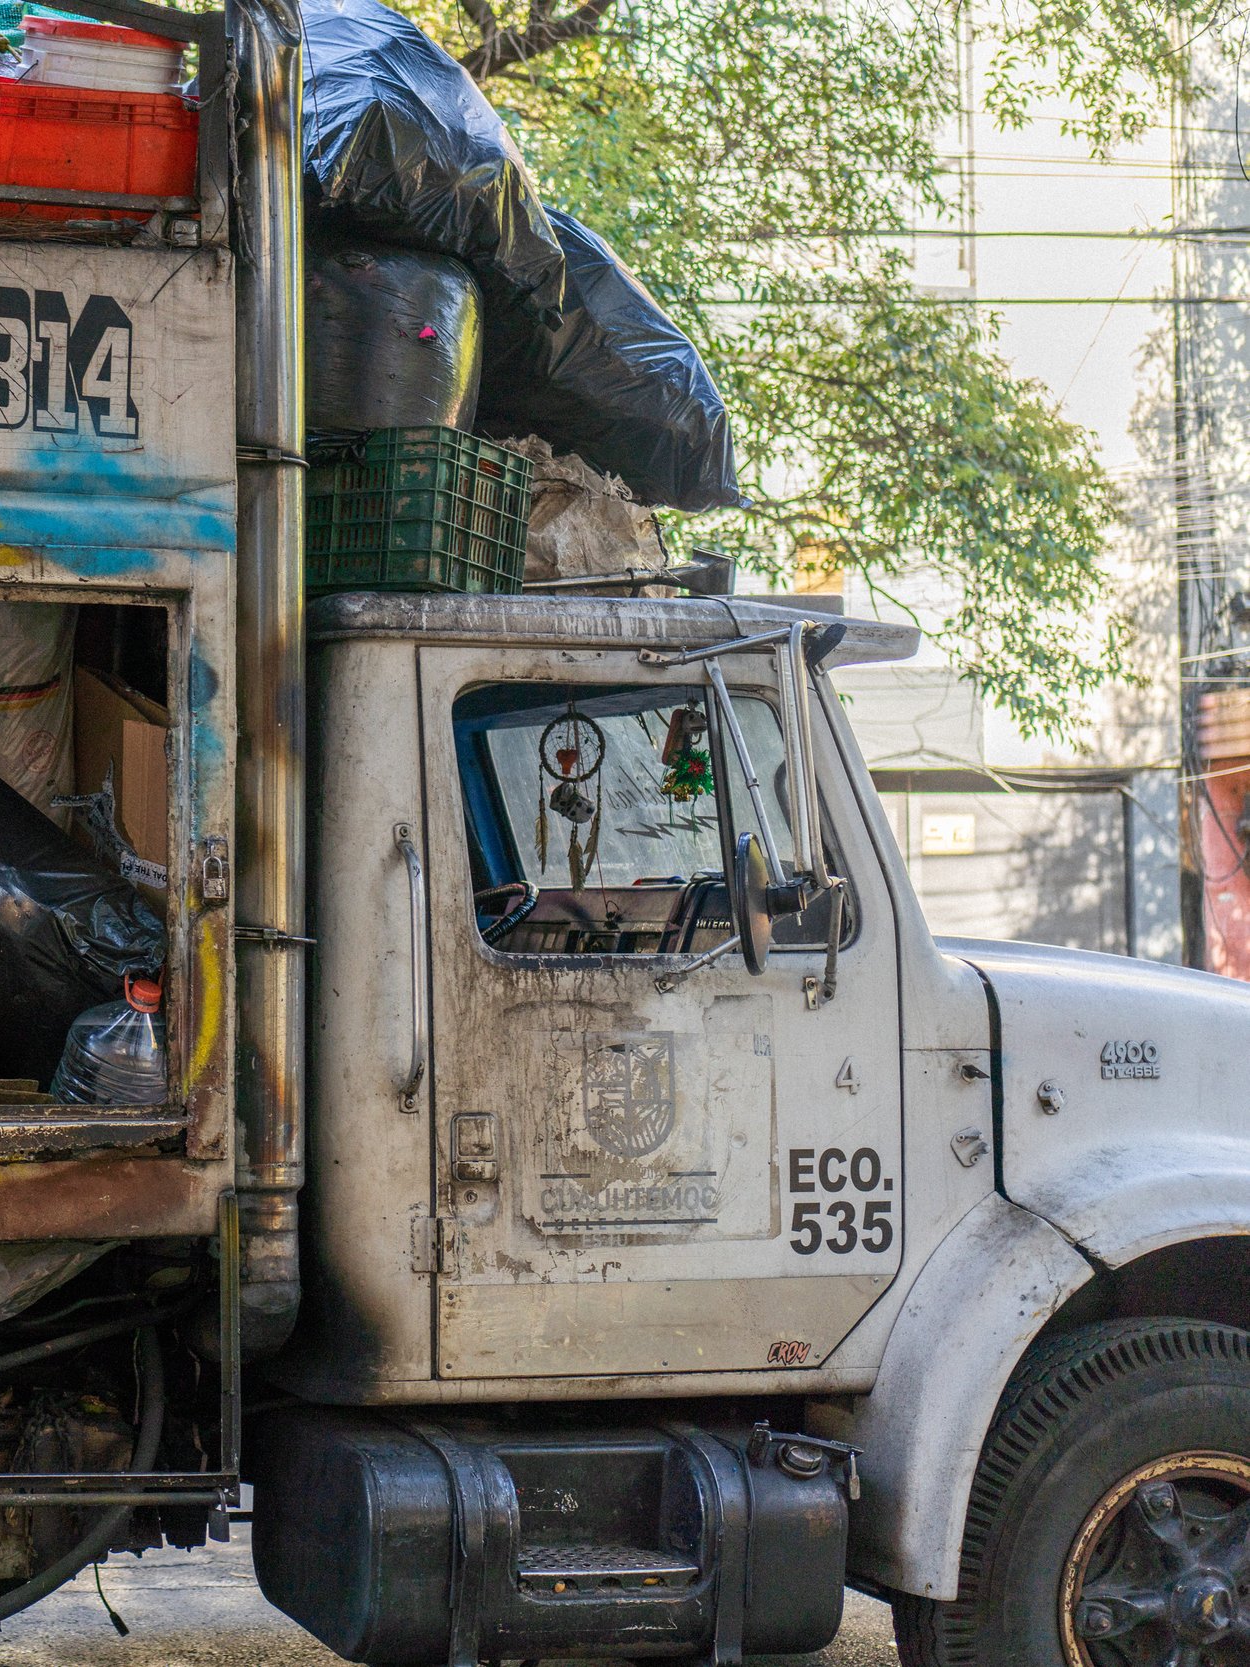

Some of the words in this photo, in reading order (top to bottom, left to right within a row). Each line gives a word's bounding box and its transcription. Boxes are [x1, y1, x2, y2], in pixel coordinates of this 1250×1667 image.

[134, 864, 151, 877] THE
[1100, 1040, 1159, 1064] 4900
[835, 1055, 862, 1095] 4
[789, 1147, 894, 1193] ECO.
[789, 1200, 894, 1255] 535
